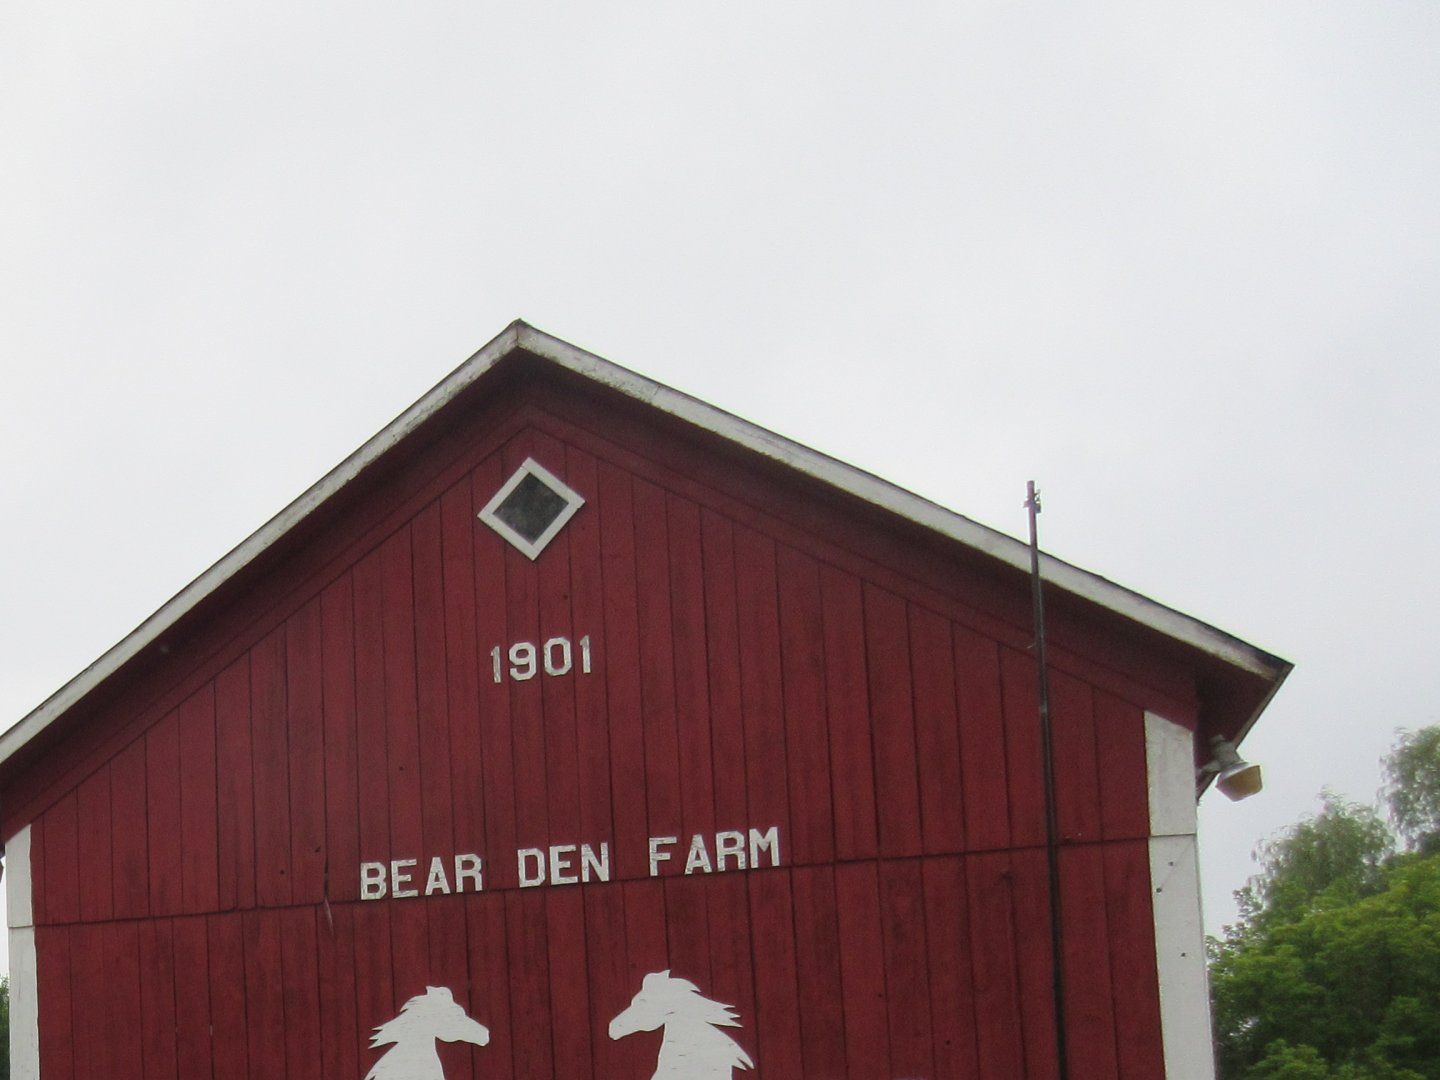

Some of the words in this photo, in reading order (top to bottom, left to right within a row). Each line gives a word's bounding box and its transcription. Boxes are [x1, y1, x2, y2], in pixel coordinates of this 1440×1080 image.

[490, 635, 592, 684] 1901
[360, 853, 483, 900] BEAR
[517, 842, 610, 888] DEN
[649, 826, 780, 876] FARM
